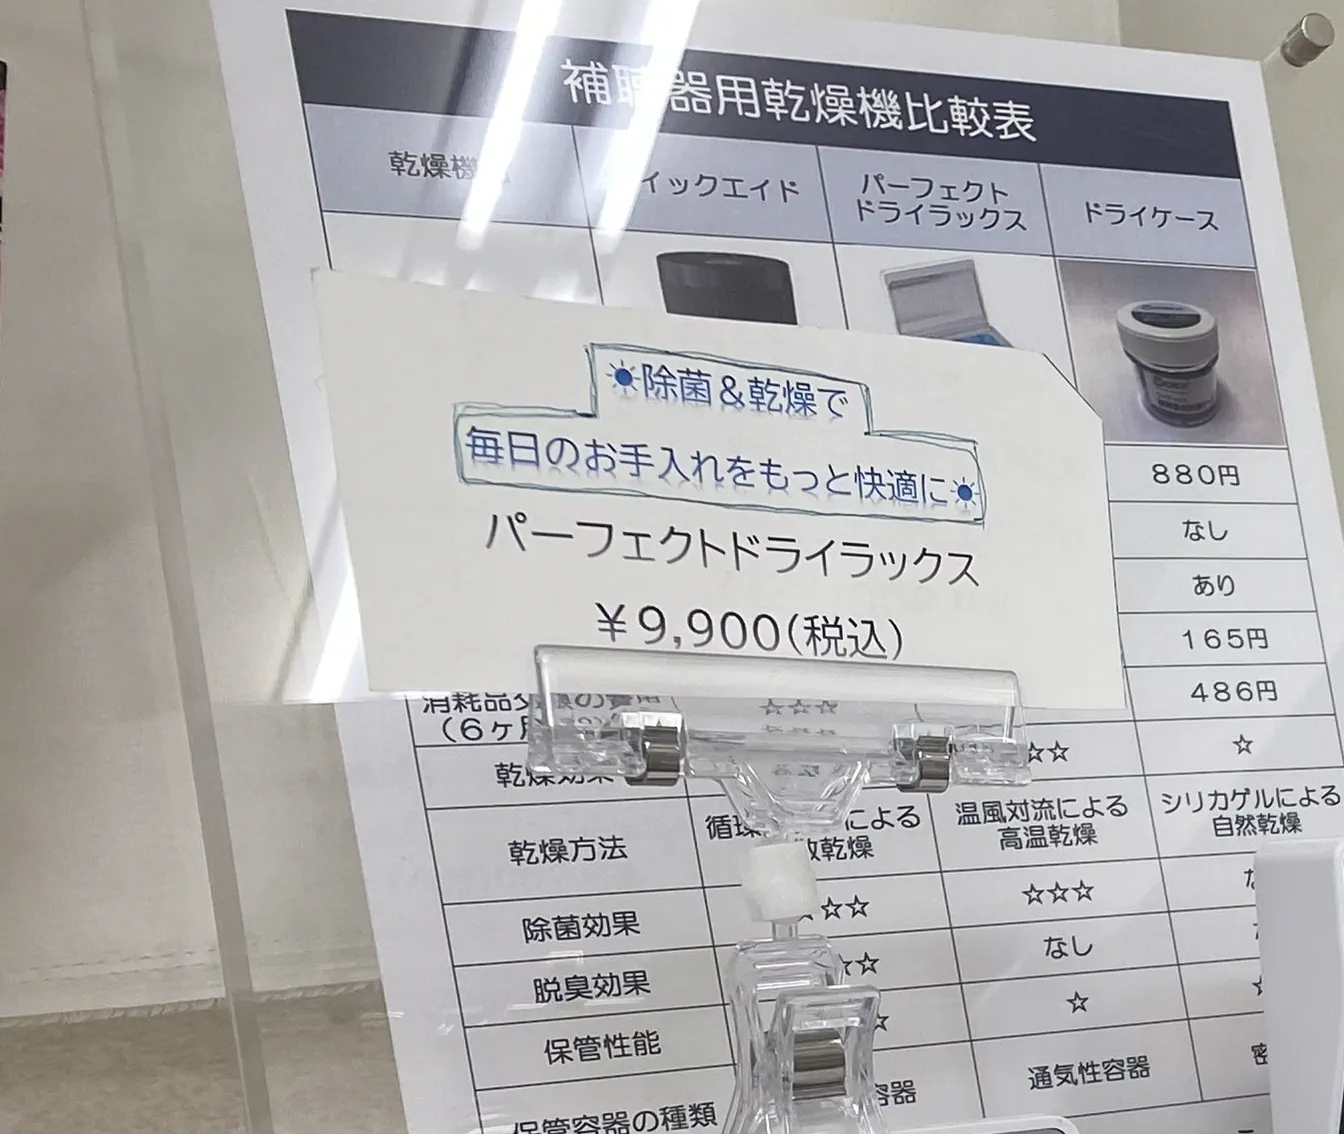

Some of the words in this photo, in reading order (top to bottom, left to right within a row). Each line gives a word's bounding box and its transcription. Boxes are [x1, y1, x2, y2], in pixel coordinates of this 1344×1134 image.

[388, 150, 486, 183] 乾燥機
[641, 169, 800, 203] イックエイド
[861, 172, 1009, 204] パーフェクト
[856, 199, 1028, 232] ドライラックス
[1084, 200, 1220, 232] ドライケース
[465, 424, 949, 504] 毎日のお手入れをもっと快適に
[1151, 463, 1241, 487] 880円
[1181, 519, 1229, 542] なし
[485, 512, 980, 588] パーフェクトドライラックス
[1192, 573, 1236, 597] あり
[596, 601, 904, 660] ¥9,900(税込)
[1181, 627, 1269, 650] 165円
[1190, 680, 1279, 702] 486円
[955, 794, 1130, 827] 温風対流による
[1160, 784, 1342, 815] シリカゲルによる
[997, 824, 1099, 851] 高温乾燥
[1213, 813, 1303, 838] 自然乾燥
[508, 835, 629, 866] 乾燥方法
[522, 910, 641, 945] 除菌効果
[1044, 934, 1094, 960] なし
[533, 970, 651, 1004] 脱臭効果
[544, 1028, 662, 1065] 保管性能
[1027, 1055, 1152, 1091] 通気性容器
